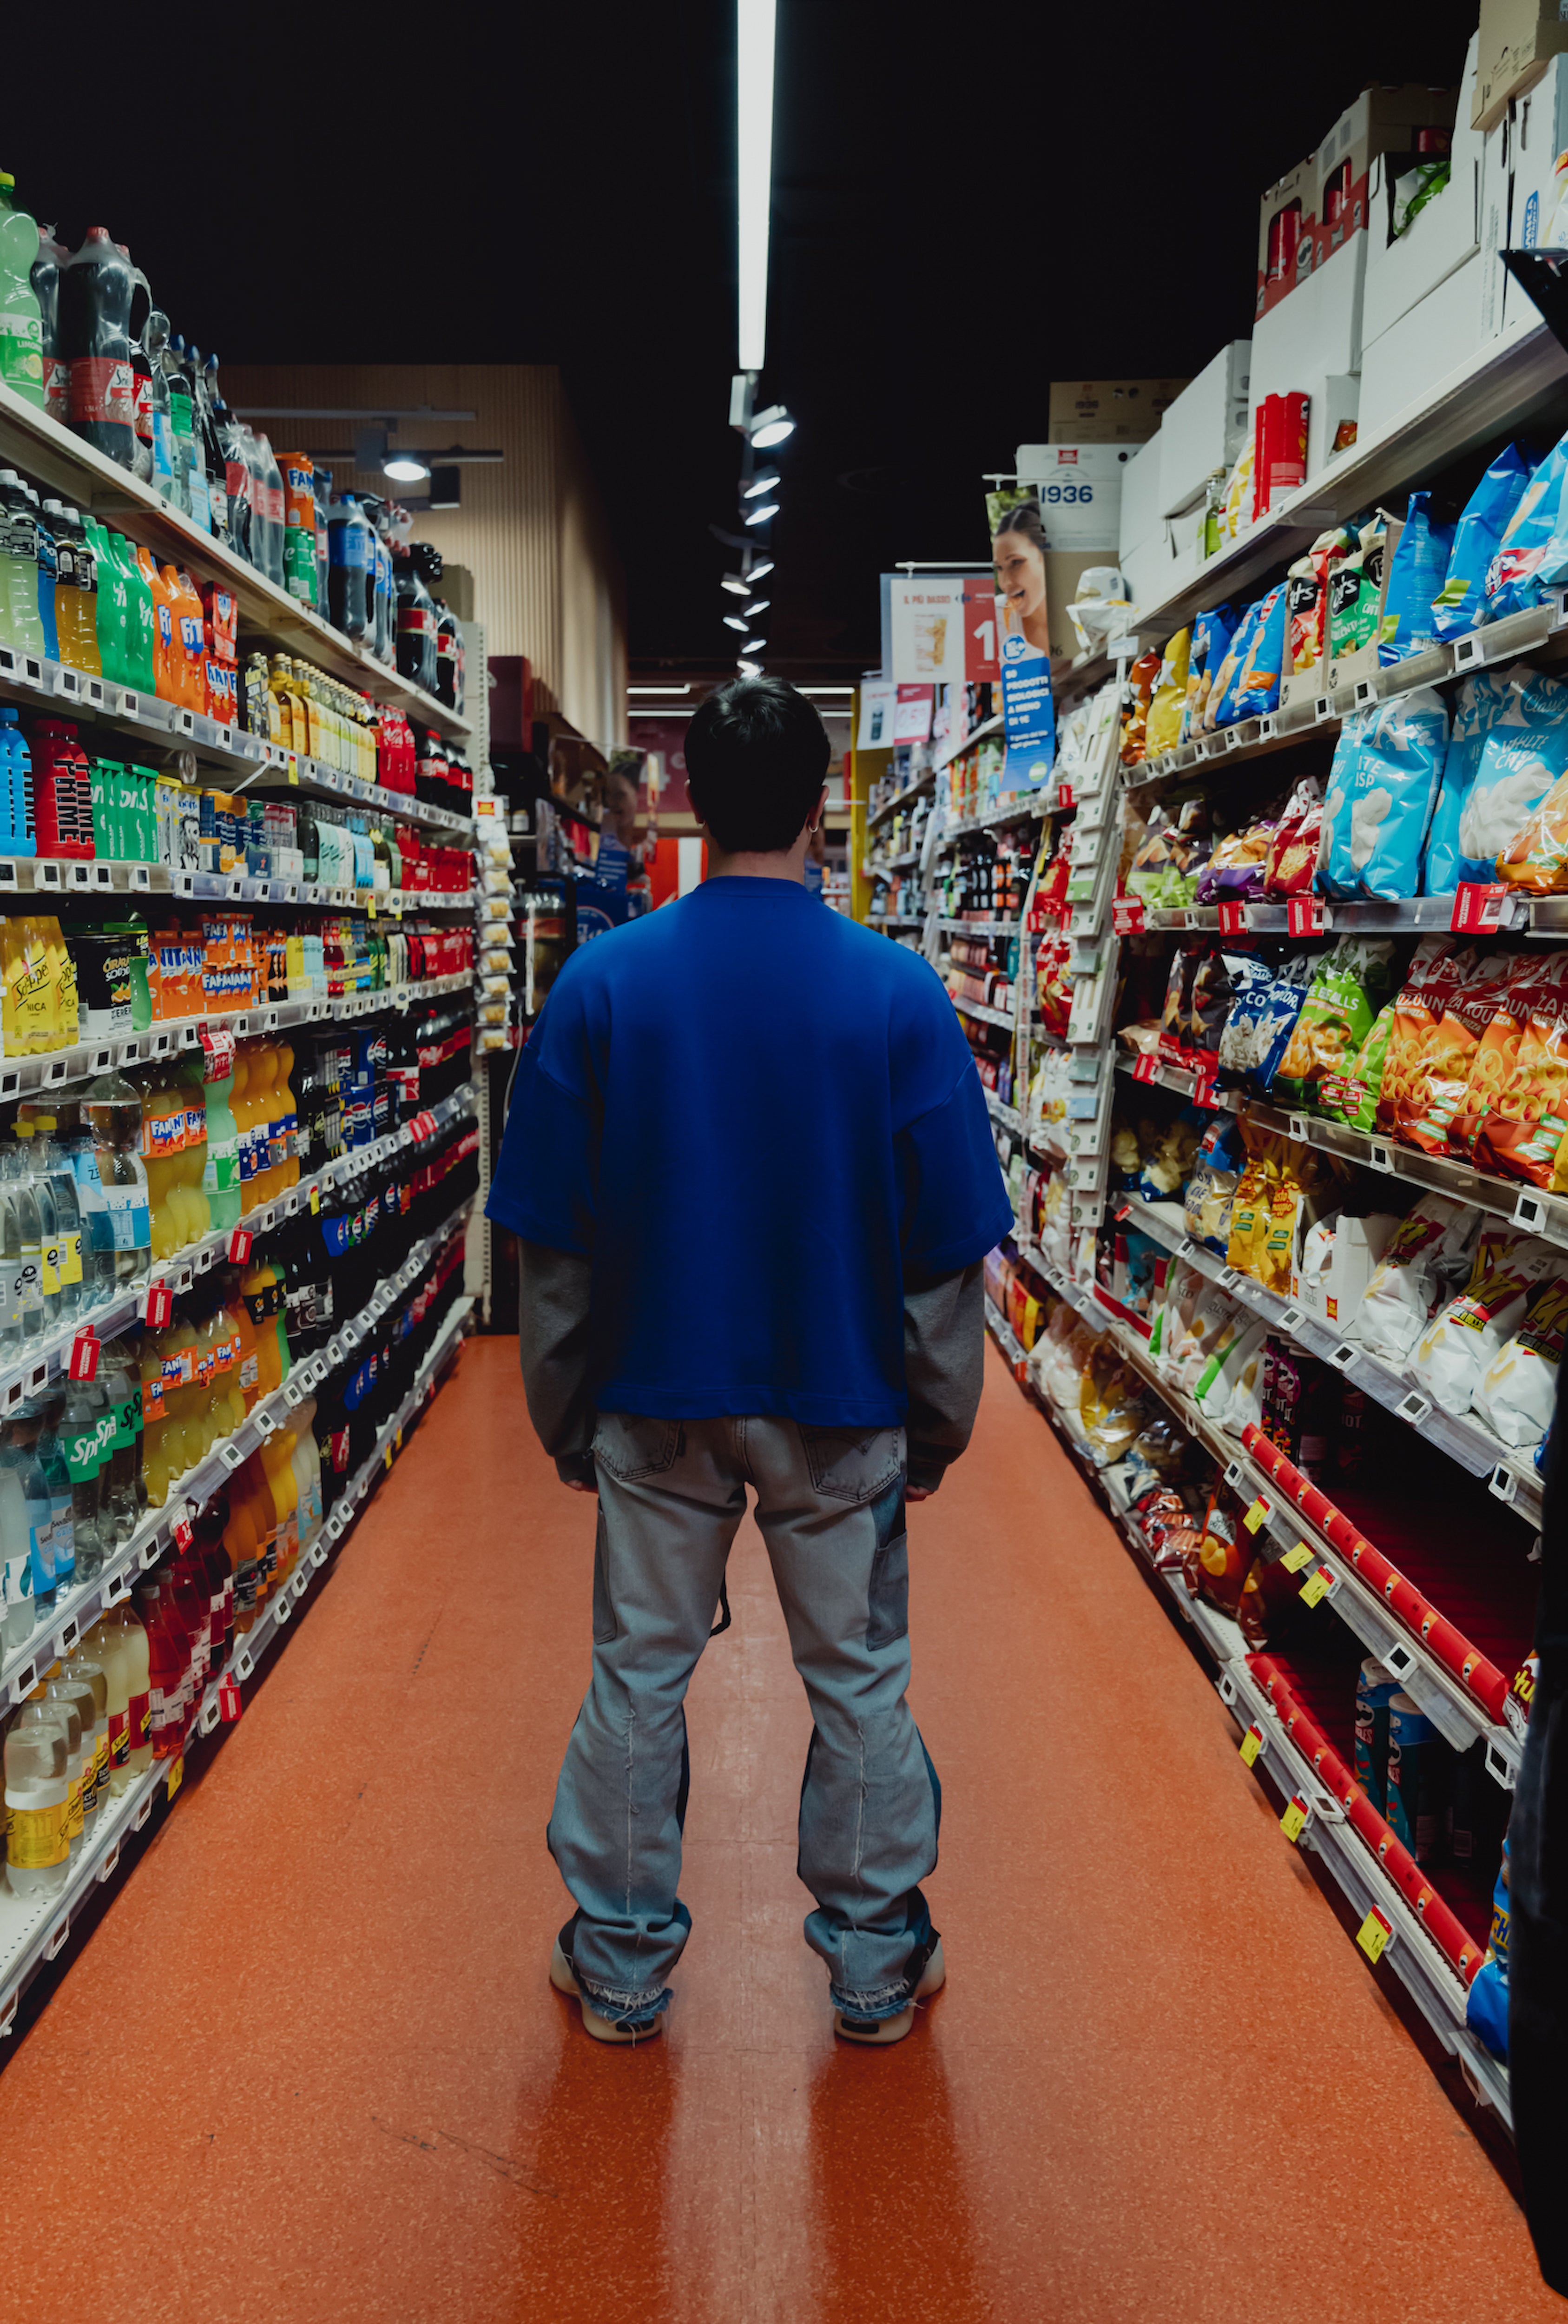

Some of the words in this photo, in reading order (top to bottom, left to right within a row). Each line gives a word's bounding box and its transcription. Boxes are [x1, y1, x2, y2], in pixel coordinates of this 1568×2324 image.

[1525, 198, 1534, 249] MICA
[1041, 485, 1093, 503] 1936
[1357, 755, 1386, 775] ITE
[1354, 771, 1376, 788] ISP
[53, 759, 79, 844] PRIME
[1457, 886, 1469, 928] CONVENIENZA
[1462, 891, 1472, 925] GARANTITA
[26, 1002, 46, 1012] NICA
[88, 1169, 100, 1180] ZE
[78, 1341, 88, 1378] CONVENIENZA
[83, 1345, 92, 1374] GARANTITA
[162, 1355, 182, 1375] FANT
